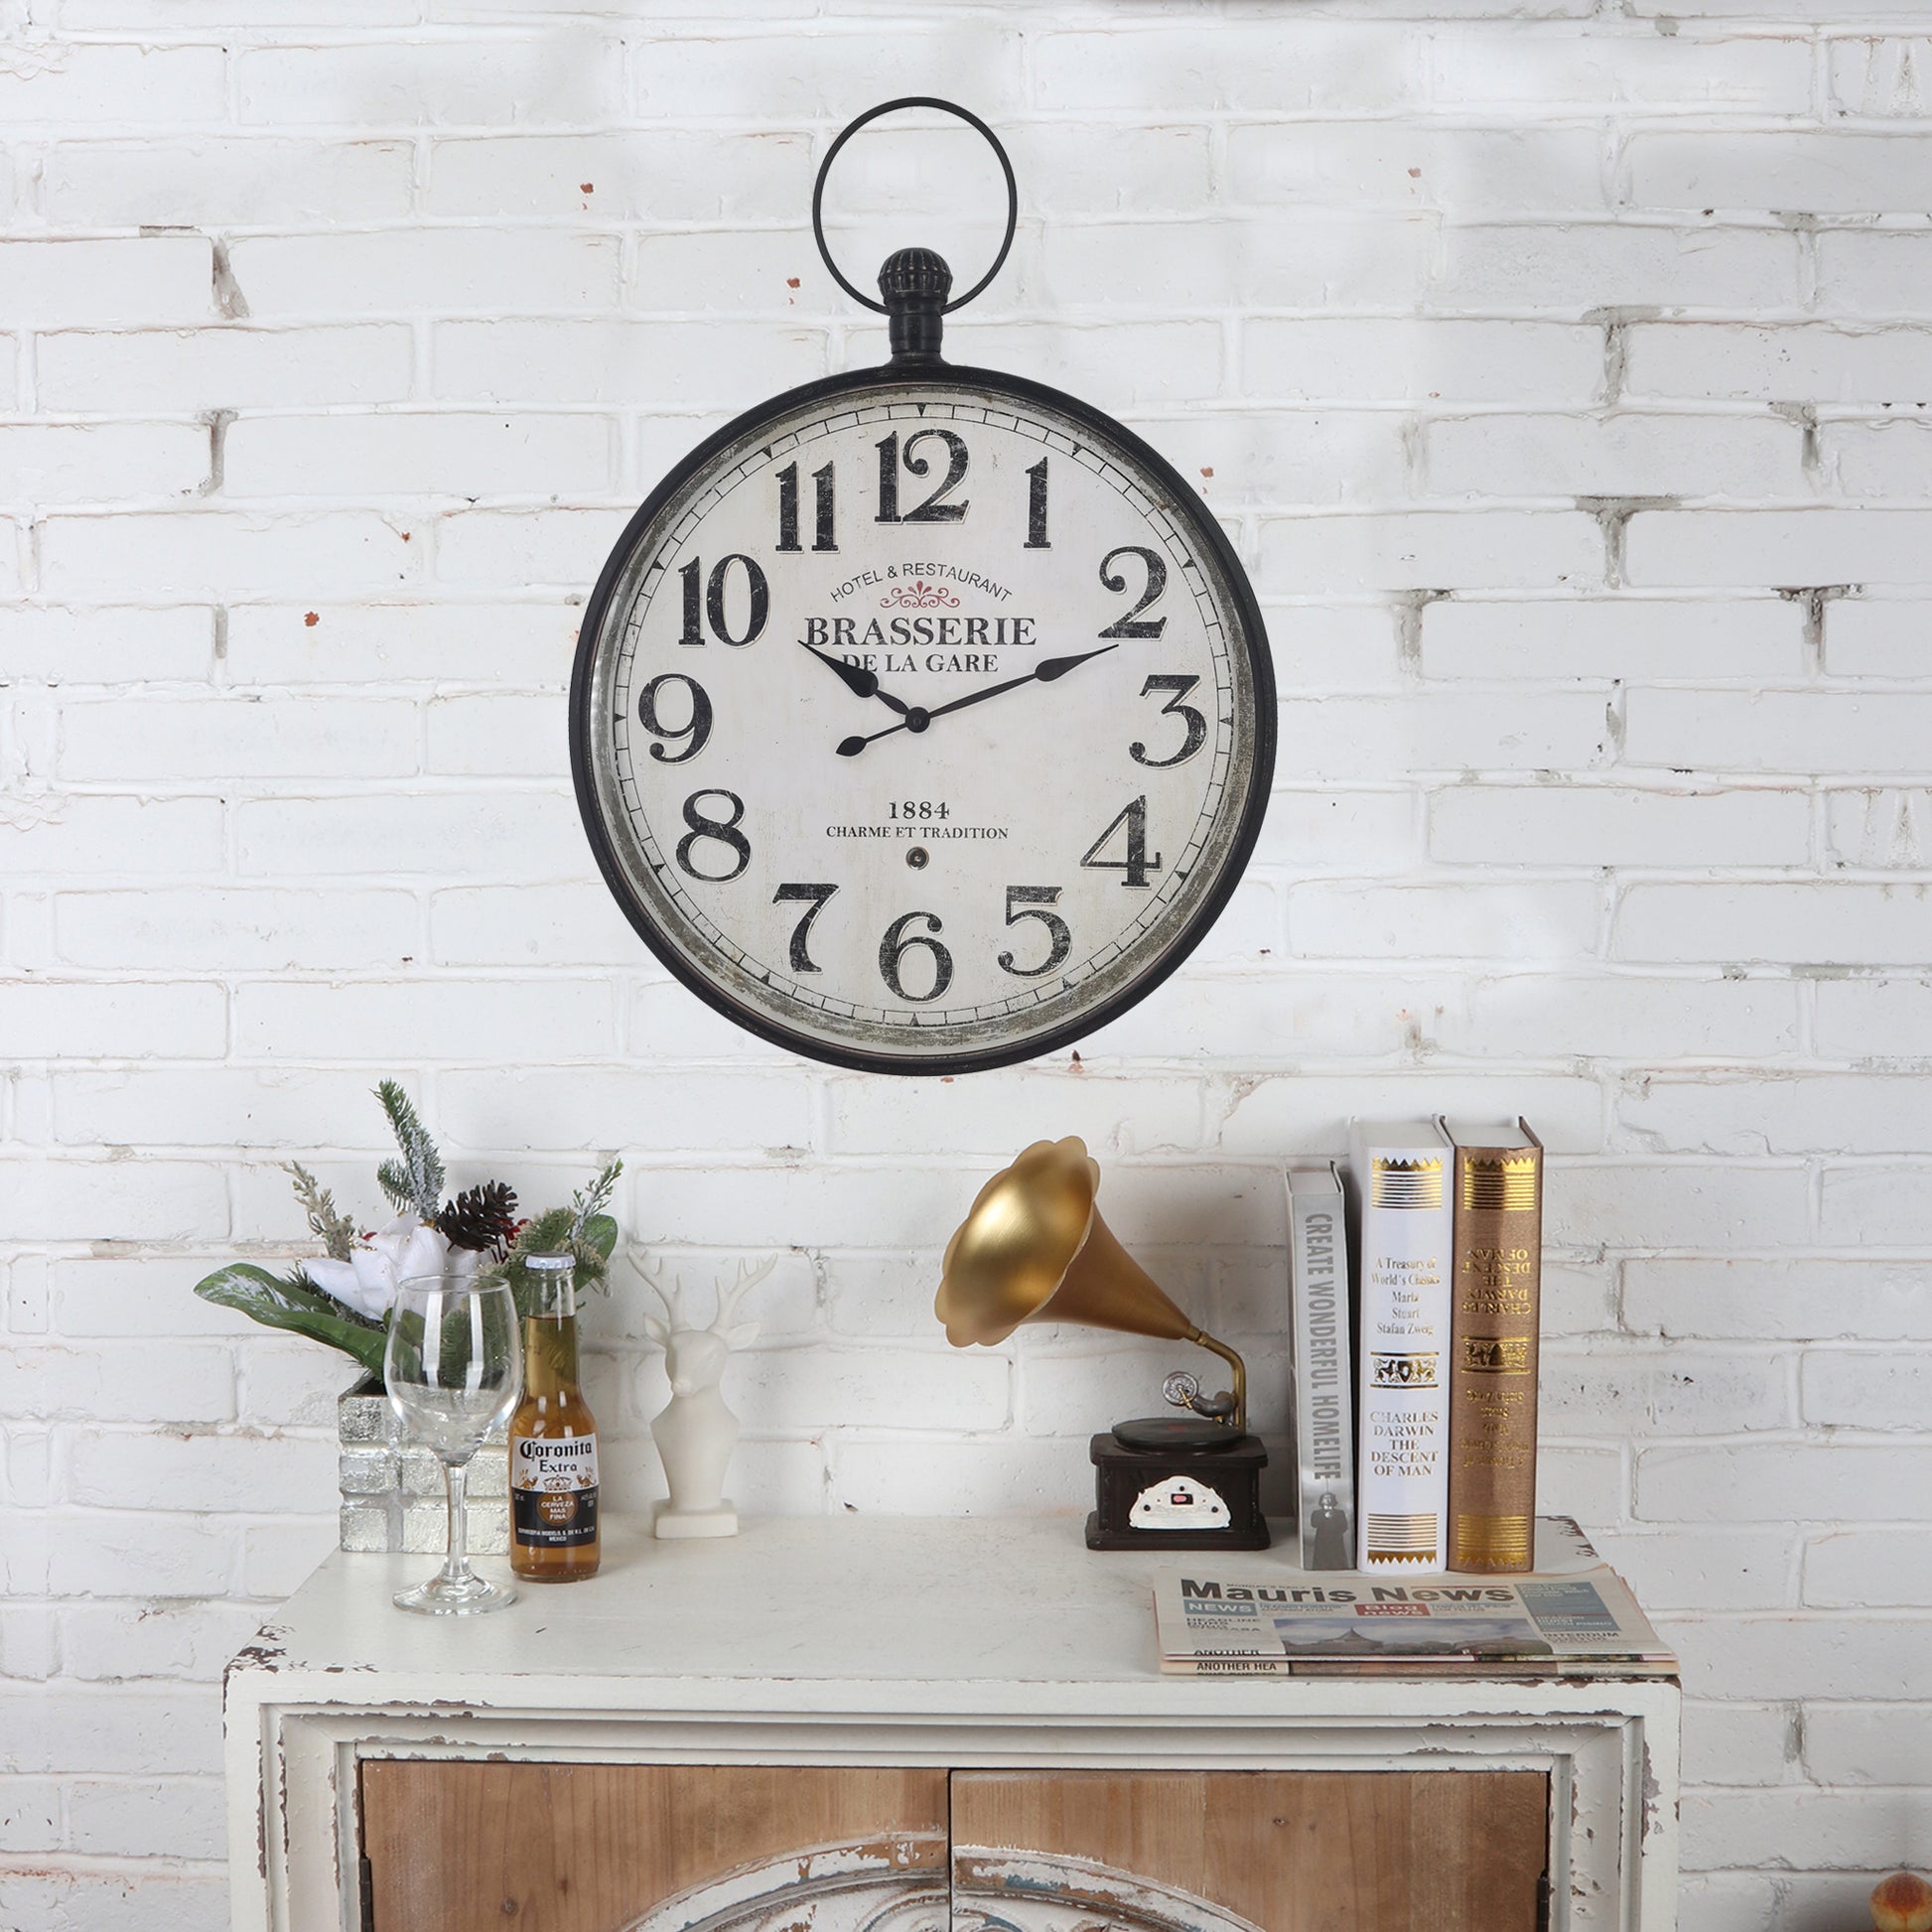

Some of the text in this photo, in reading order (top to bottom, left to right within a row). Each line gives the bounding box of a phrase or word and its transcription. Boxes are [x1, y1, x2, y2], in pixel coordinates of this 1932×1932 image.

[875, 429, 969, 525] 12
[775, 460, 838, 551] 11
[1023, 457, 1051, 548] 1
[830, 563, 1013, 603] HOTEL & RESTAURANT
[1098, 546, 1168, 638] 2
[678, 554, 768, 647] 10
[804, 617, 1036, 646] BRASSERIE
[843, 654, 999, 672] DE LA GARE
[638, 674, 712, 762] 9
[1129, 675, 1206, 766] 3
[889, 800, 950, 820] 1884
[676, 789, 752, 881] 8
[826, 826, 1009, 839] CHARME ET TRADITION
[1081, 795, 1162, 887] 4
[772, 884, 839, 972] 7
[998, 886, 1071, 977] 5
[879, 911, 952, 1001] 6
[1305, 1213, 1341, 1480] CREATE WONDERFUL HOMELIFE
[1370, 1411, 1439, 1423] CHARLES
[1374, 1425, 1435, 1437] DARWIN
[519, 1440, 593, 1461] Coronita
[1371, 1450, 1439, 1463] DESCENT
[1389, 1439, 1420, 1450] THE
[539, 1459, 578, 1472] Extra
[1373, 1464, 1432, 1476] OF MAN
[1180, 1579, 1357, 1602] Mauris
[1371, 1587, 1514, 1601] News
[1188, 1602, 1252, 1612] NEWS
[1196, 1662, 1252, 1671] ANOTHER
